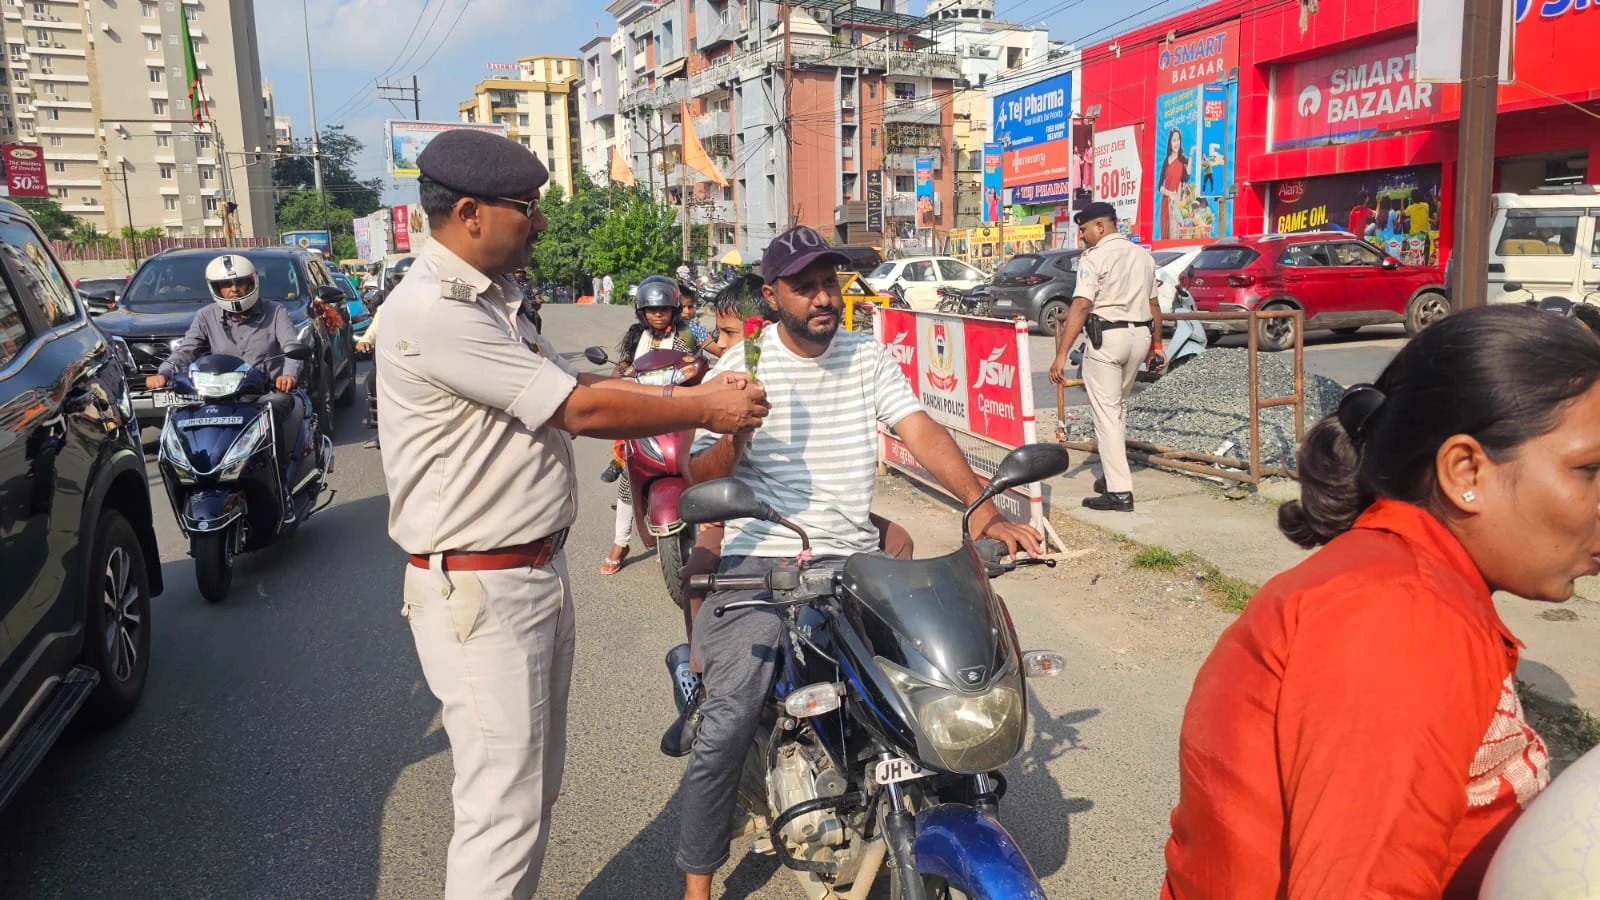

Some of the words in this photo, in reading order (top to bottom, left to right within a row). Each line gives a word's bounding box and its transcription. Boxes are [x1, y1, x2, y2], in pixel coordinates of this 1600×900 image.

[1173, 32, 1226, 66] SMART
[1171, 58, 1224, 84] BAZAAR
[1330, 53, 1416, 95] SMART
[1008, 96, 1022, 122] Tej
[1024, 88, 1064, 116] Pharma
[1328, 82, 1433, 124] BAZAAR
[1099, 156, 1112, 169] SALE
[12, 176, 32, 190] 50
[1121, 181, 1136, 197] OFF
[1278, 209, 1308, 234] GAME
[1310, 204, 1328, 227] ON.
[972, 359, 1015, 389] JSW
[923, 391, 943, 412] RANCHI
[943, 398, 965, 418] POLICE
[978, 393, 1015, 421] Cement
